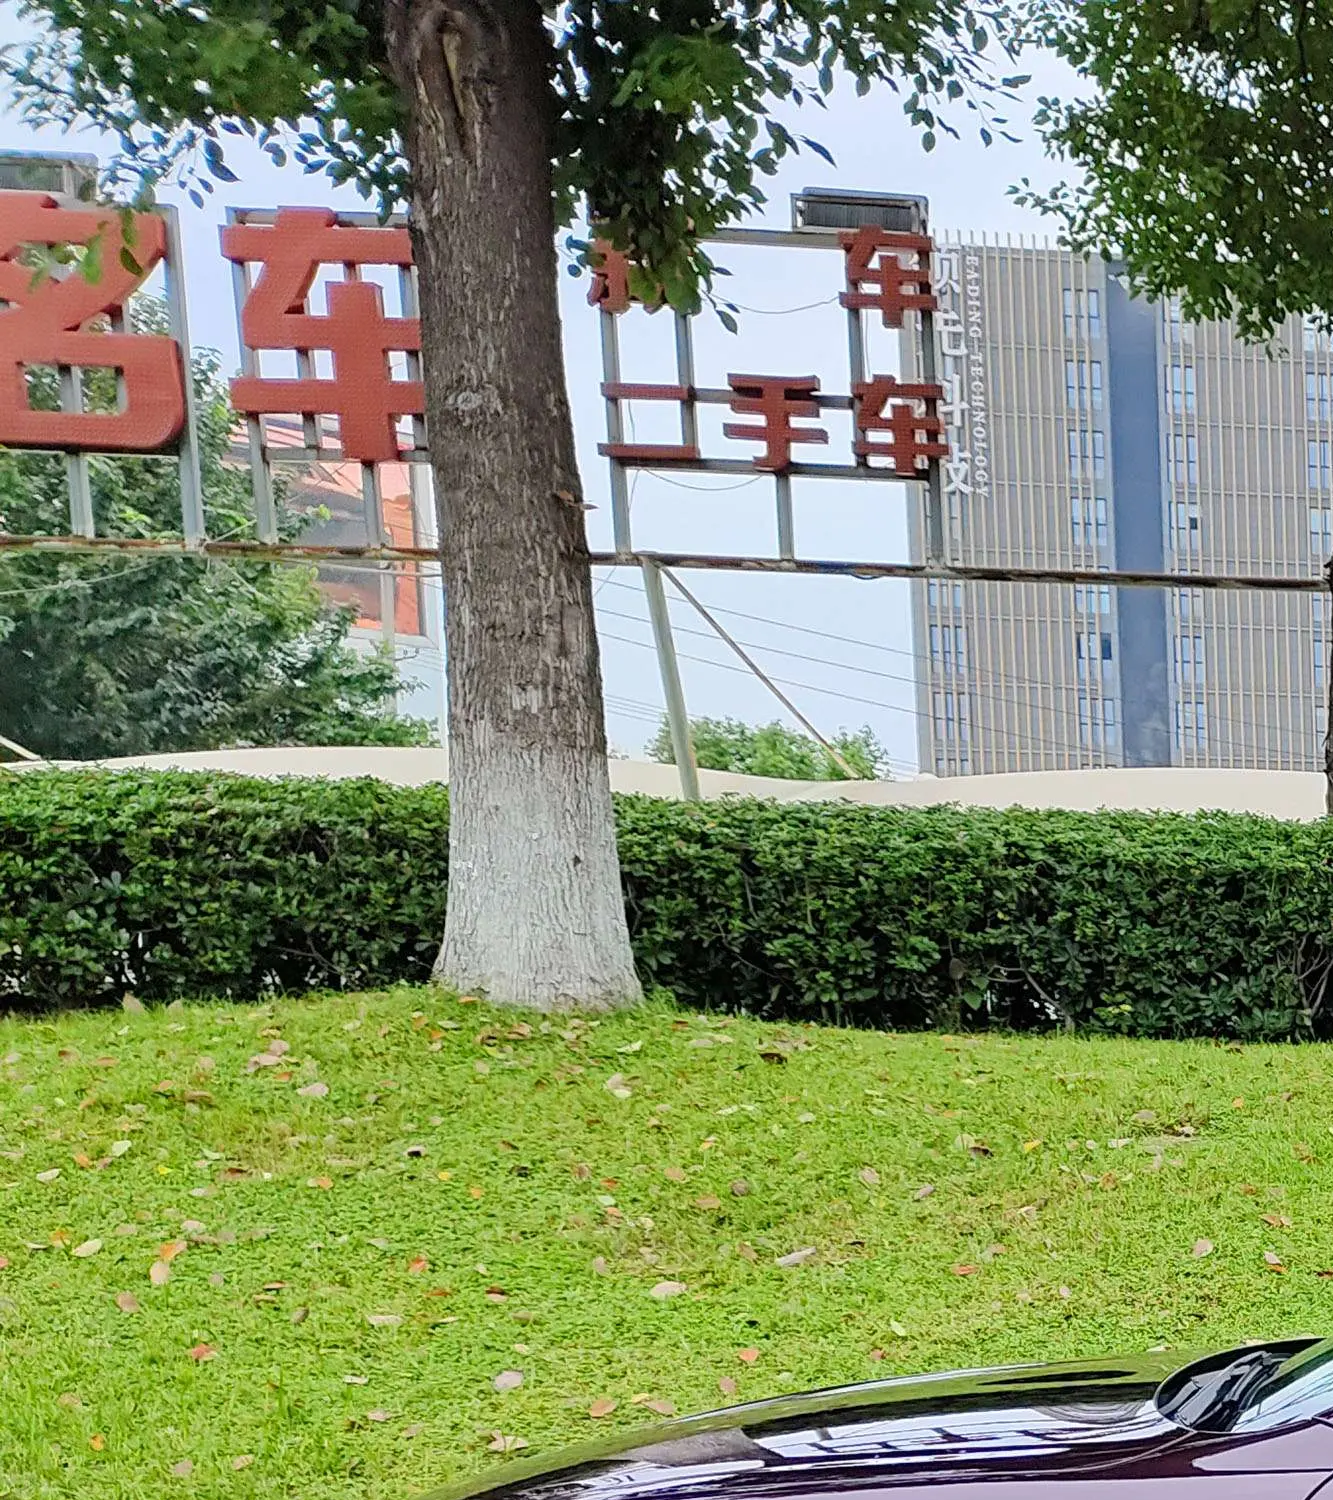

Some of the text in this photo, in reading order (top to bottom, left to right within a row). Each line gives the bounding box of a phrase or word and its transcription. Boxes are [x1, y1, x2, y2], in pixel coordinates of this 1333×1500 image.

[597, 373, 950, 477] 二手车
[969, 351, 990, 498] TECHNOLOGY
